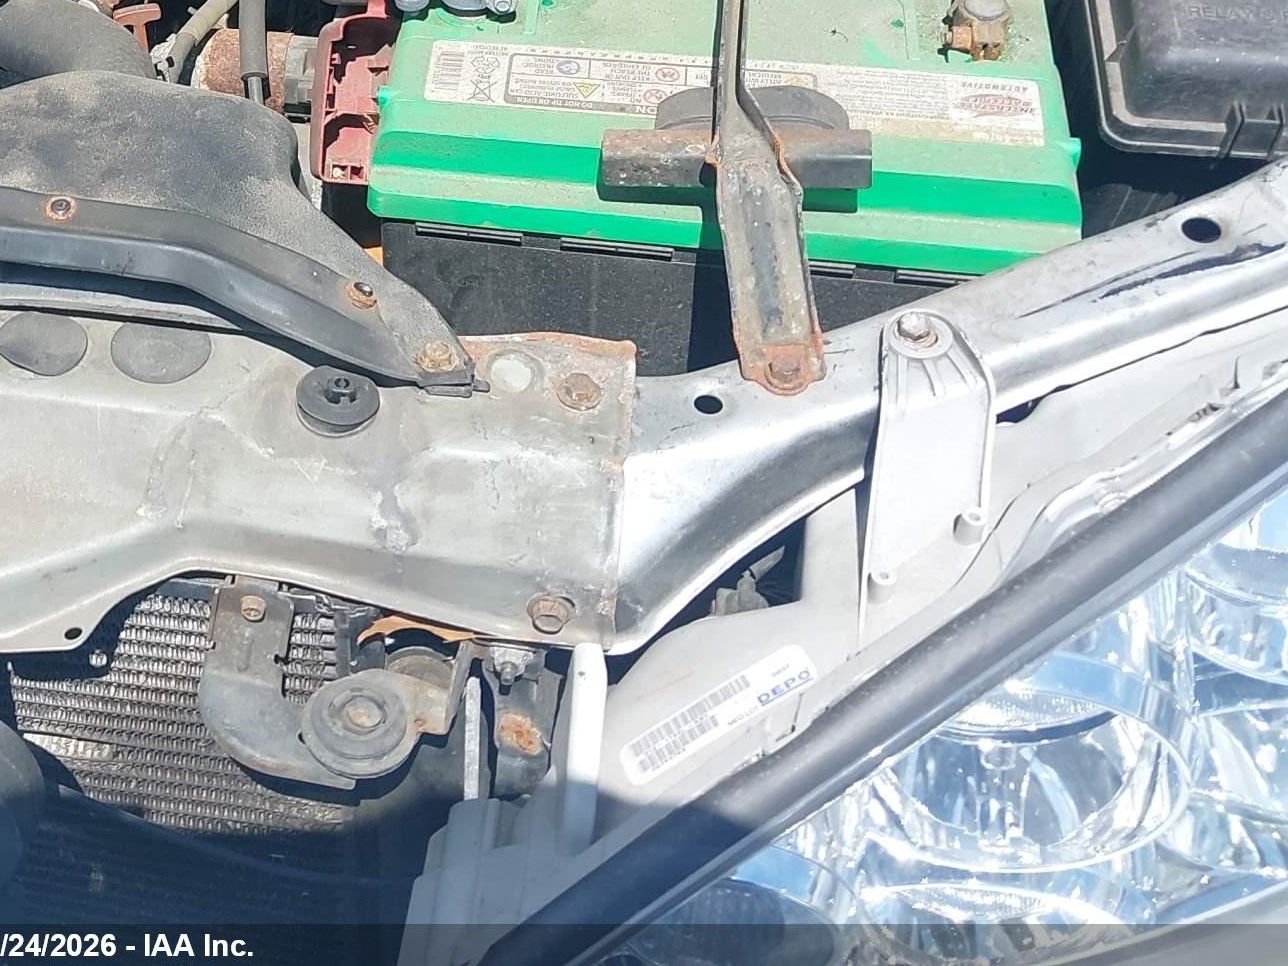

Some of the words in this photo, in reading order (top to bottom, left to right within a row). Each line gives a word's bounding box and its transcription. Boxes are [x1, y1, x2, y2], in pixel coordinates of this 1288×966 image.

[1187, 5, 1253, 21] RELAY
[961, 81, 1028, 92] AUTOMOTIVE
[757, 668, 811, 705] DEPO
